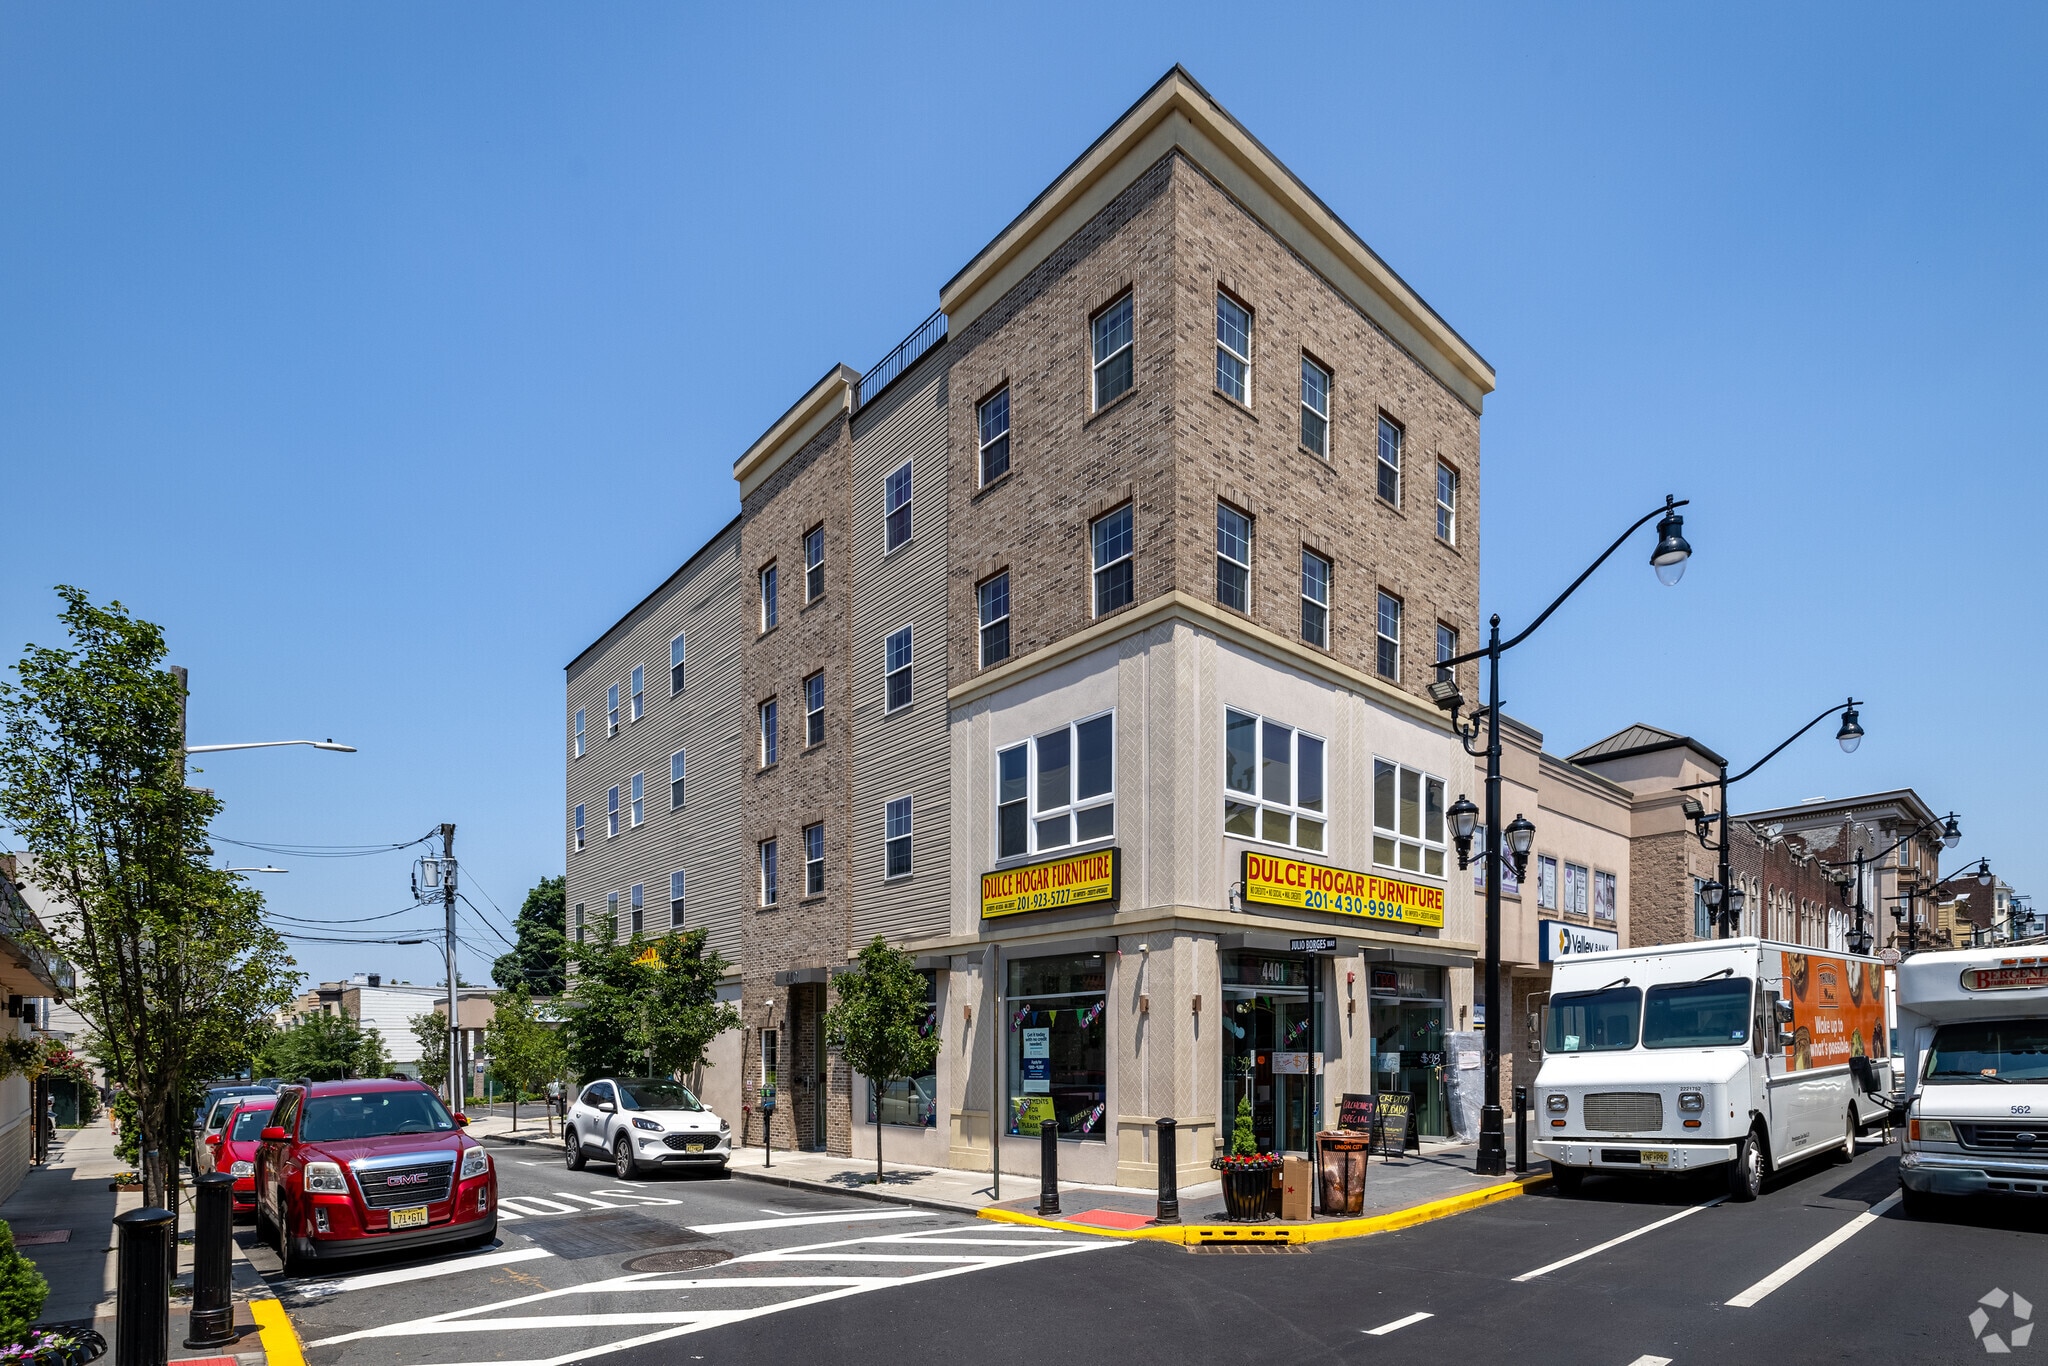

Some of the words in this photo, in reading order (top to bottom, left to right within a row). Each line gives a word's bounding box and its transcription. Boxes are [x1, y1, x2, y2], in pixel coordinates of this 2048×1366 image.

[984, 874, 1013, 899] DULCE
[1015, 867, 1049, 894] HOGAR
[1052, 855, 1109, 887] FURNITURE
[1248, 855, 1307, 888] DULCE
[1310, 867, 1364, 897] HOGAR
[1369, 877, 1443, 910] FURNITURE
[1017, 888, 1070, 911] 201-923-5727
[1304, 889, 1403, 920] 201-430-9994
[1291, 940, 1306, 950] JULIO
[1306, 939, 1326, 949] BORGES
[1571, 934, 1594, 954] Valley
[1595, 943, 1610, 952] BANK
[1262, 962, 1284, 981] 4401
[1011, 1004, 1031, 1032] Crédito
[1081, 1000, 1105, 1029] Crédito
[1814, 1015, 1830, 1034] Wake
[1831, 1019, 1838, 1038] up
[1838, 1017, 1844, 1033] to
[1810, 1038, 1829, 1057] what's
[1828, 1035, 1850, 1060] possible.
[1083, 1103, 1105, 1134] Crédito
[2011, 1105, 2031, 1114] 562
[387, 1173, 429, 1187] GMC
